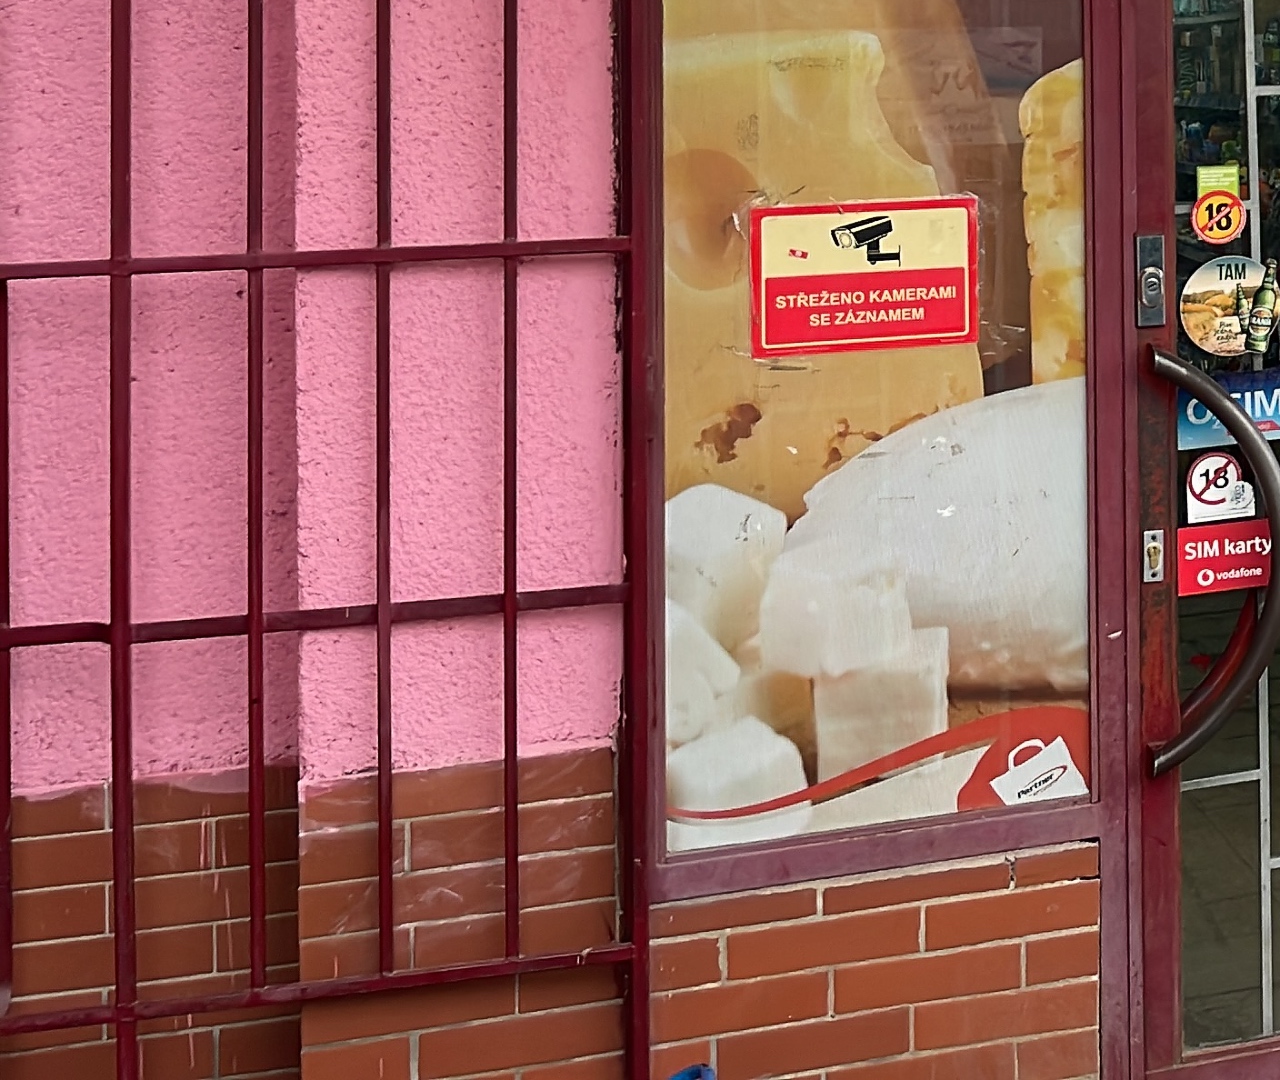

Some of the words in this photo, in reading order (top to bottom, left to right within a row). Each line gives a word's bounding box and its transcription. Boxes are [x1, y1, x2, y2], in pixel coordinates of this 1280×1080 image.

[1205, 203, 1232, 231] 18
[1217, 263, 1246, 280] TAM
[775, 290, 865, 309] STŘEŽENO
[869, 286, 956, 303] KAMERAMI
[809, 313, 831, 327] SE
[834, 307, 925, 326] ZÁZNAMEM
[1199, 467, 1229, 490] 18
[1184, 540, 1220, 560] SIM
[1224, 535, 1272, 556] karty
[1216, 566, 1262, 581] vodafone
[1017, 773, 1054, 799] Partner
